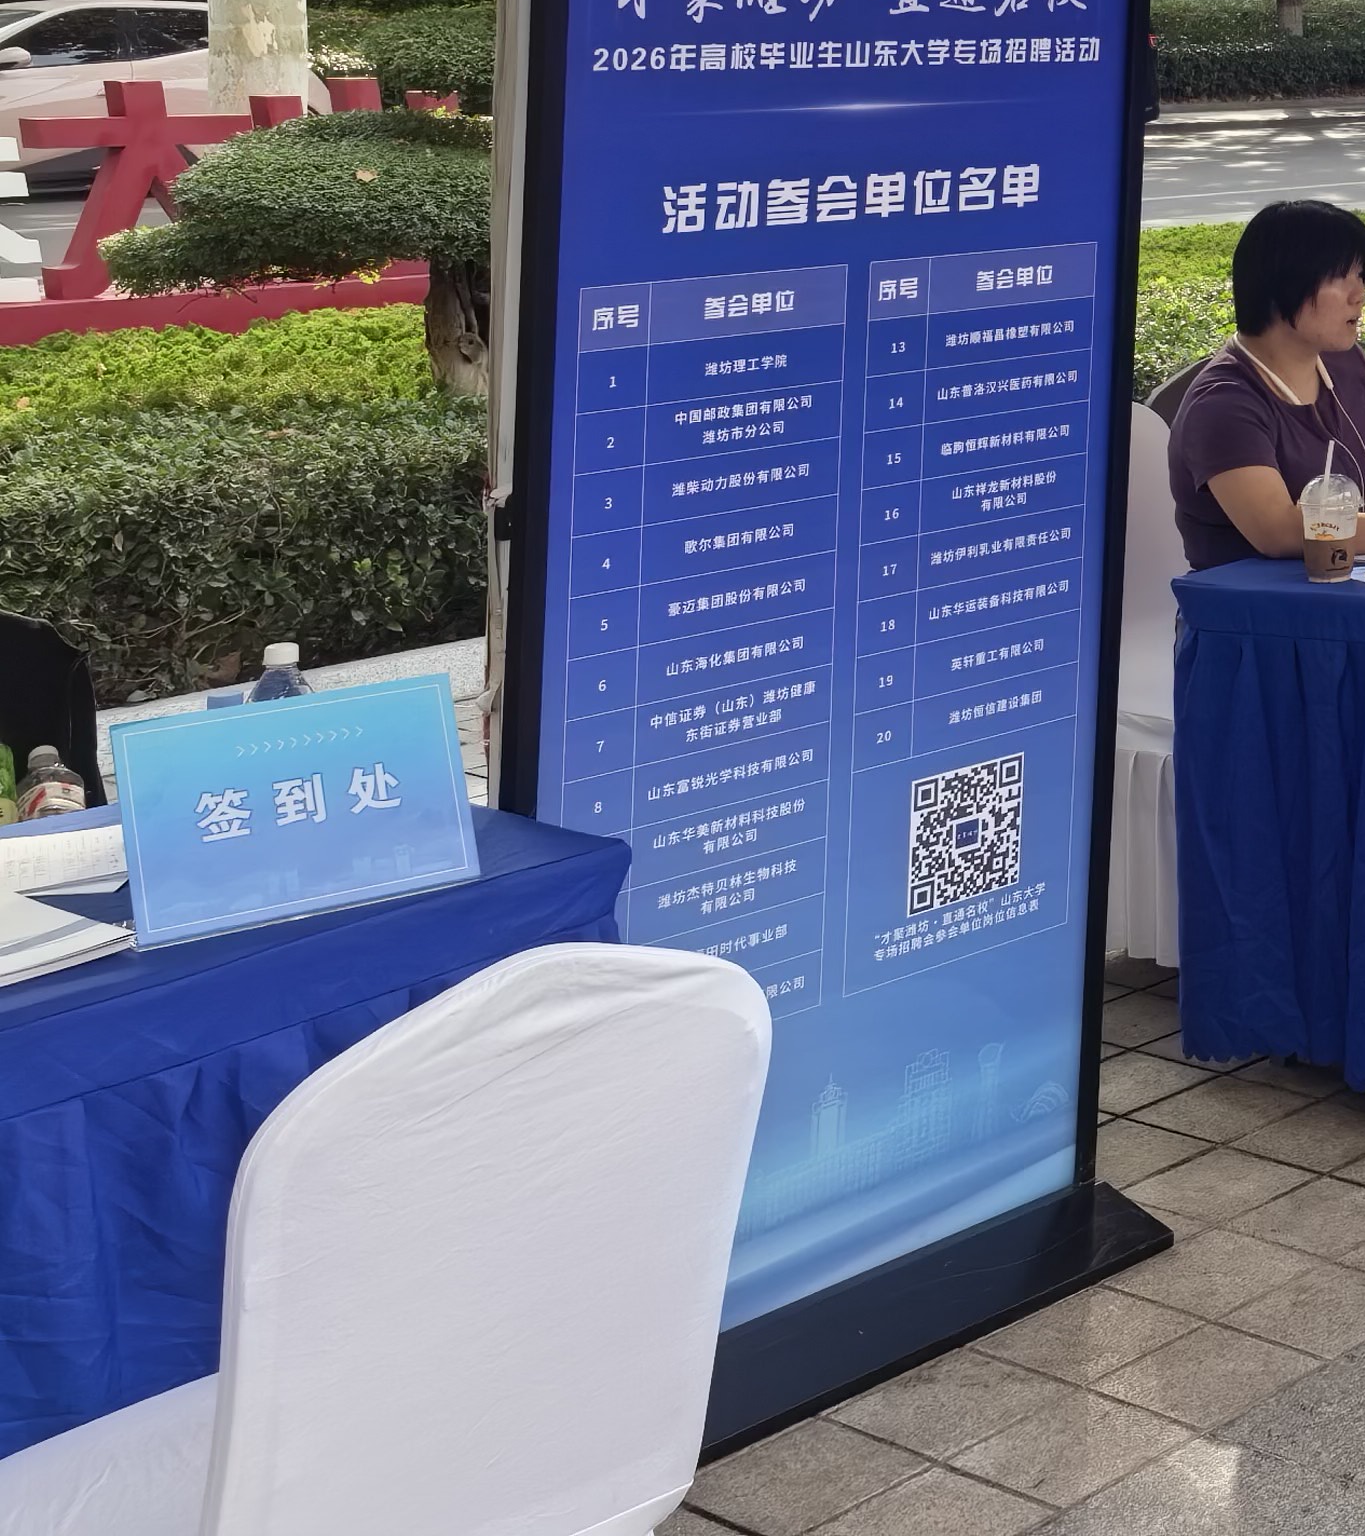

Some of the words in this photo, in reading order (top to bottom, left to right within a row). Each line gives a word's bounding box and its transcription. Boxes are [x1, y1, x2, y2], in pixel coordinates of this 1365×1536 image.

[592, 35, 1101, 74] 2026年高校毕业生山东大学专场招聘活动
[661, 162, 1042, 236] 活动参会单位名单
[878, 276, 919, 302] 序号
[975, 265, 1053, 293] 参会单位
[592, 303, 640, 332] 序号
[703, 289, 795, 321] 参会单位
[890, 341, 906, 354] 13
[704, 353, 788, 378] 潍坊理工学院
[608, 375, 617, 389] 1
[936, 369, 1079, 402] 山东普洛汉兴医药有限公司
[674, 394, 813, 427] 中国邮政集团有限公司
[888, 397, 904, 410] 14
[606, 436, 615, 449] 2
[702, 420, 785, 445] 潍坊市分公司
[887, 453, 902, 465] 15
[671, 462, 810, 499] 潍柴动力股份有限公司
[951, 470, 1057, 501] 山东祥龙新材料股份
[604, 496, 613, 510] 3
[884, 508, 900, 521] 16
[981, 491, 1027, 514] 有限公司
[684, 522, 795, 556] 歌尔集团有限公司
[929, 527, 1072, 566] 潍坊伊利乳业有限责任公司
[601, 557, 612, 570] 4
[882, 564, 898, 577] 17
[667, 578, 807, 618] 豪迈集团股份有限公司
[928, 578, 1069, 622] 山东华运装备科技有限公司
[600, 618, 609, 632] 5
[880, 619, 896, 633] 18
[665, 635, 805, 678] 山东海化集团有限公司
[950, 637, 1045, 672] 英轩重工有限公司
[598, 679, 607, 693] 6
[878, 674, 894, 689] 19
[948, 689, 1042, 725] 潍坊恒信建设集团
[685, 708, 783, 744] 东街证券营业部
[876, 729, 892, 745] 20
[596, 740, 605, 754] 7
[647, 748, 814, 802] 山东富锐光学科技有限公司
[194, 760, 404, 846] 签到处
[593, 800, 603, 815] 8
[652, 797, 806, 850] 山东华美新材料科技股份
[702, 828, 758, 856] 有限公司
[656, 858, 798, 910] 潍坊杰特贝林生物科技
[699, 888, 756, 916] 有限公司
[763, 975, 806, 1000] 限公司
